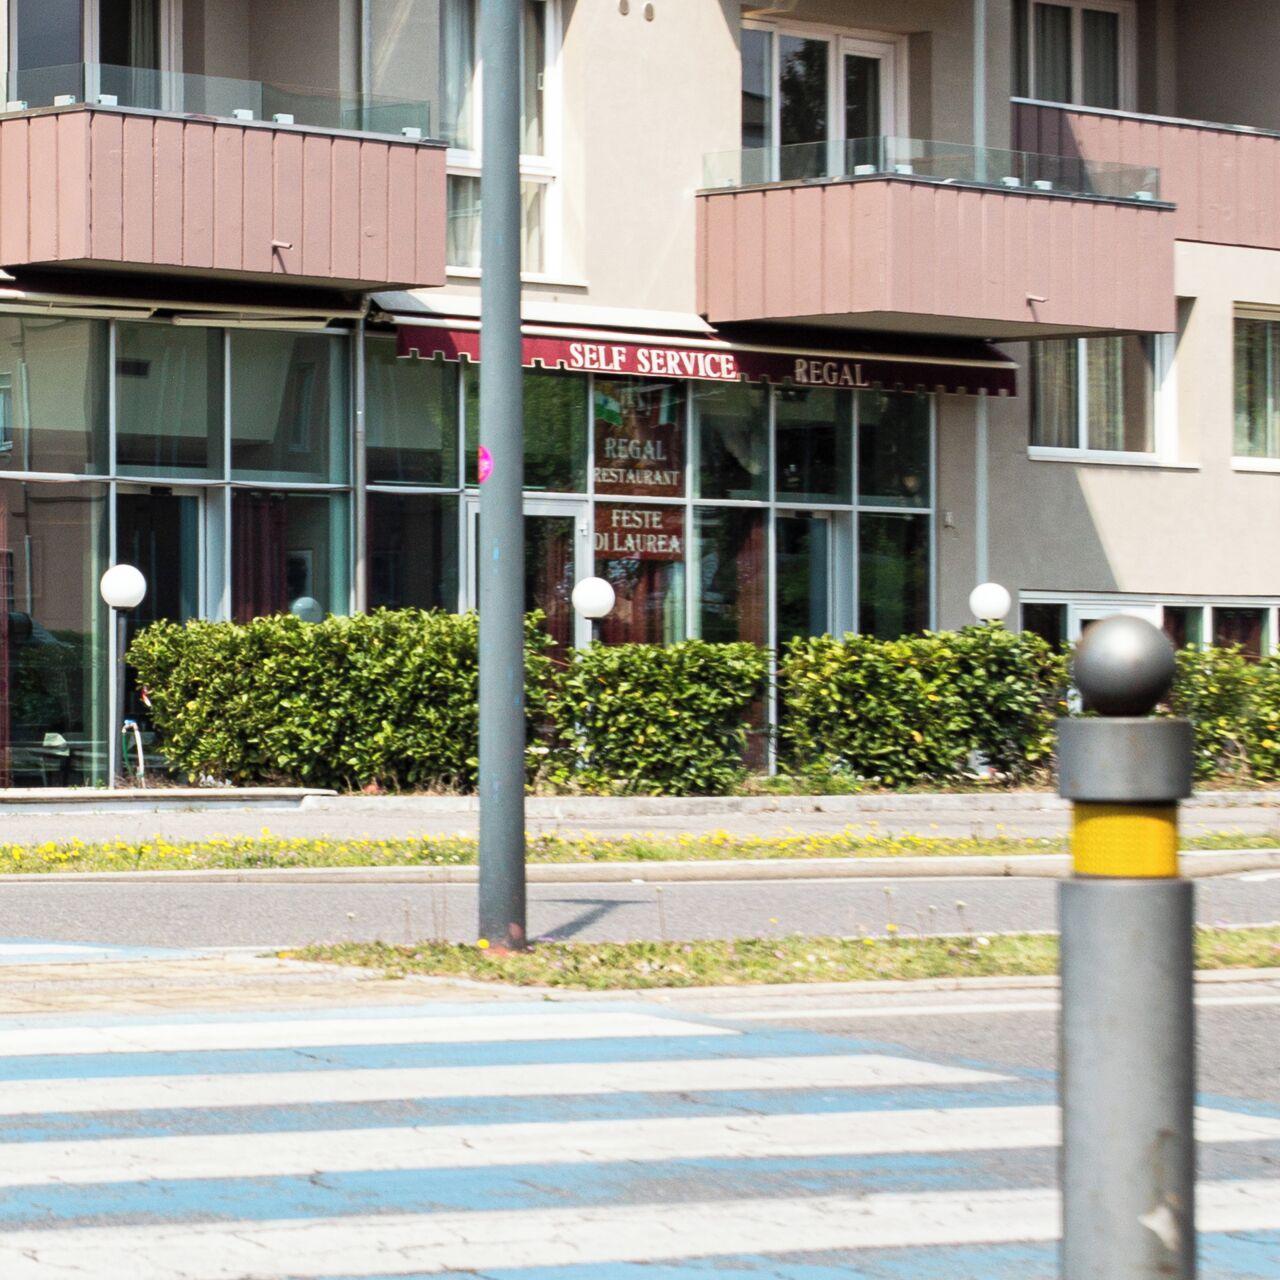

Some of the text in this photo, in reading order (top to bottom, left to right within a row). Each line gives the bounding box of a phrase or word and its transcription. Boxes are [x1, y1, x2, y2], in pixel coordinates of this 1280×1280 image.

[570, 343, 869, 386] SELF SERVICE REGAL
[604, 437, 667, 461] REGAL
[594, 467, 680, 486] RESTAURANT
[611, 509, 663, 529] FESTE
[613, 533, 681, 553] LAUREA
